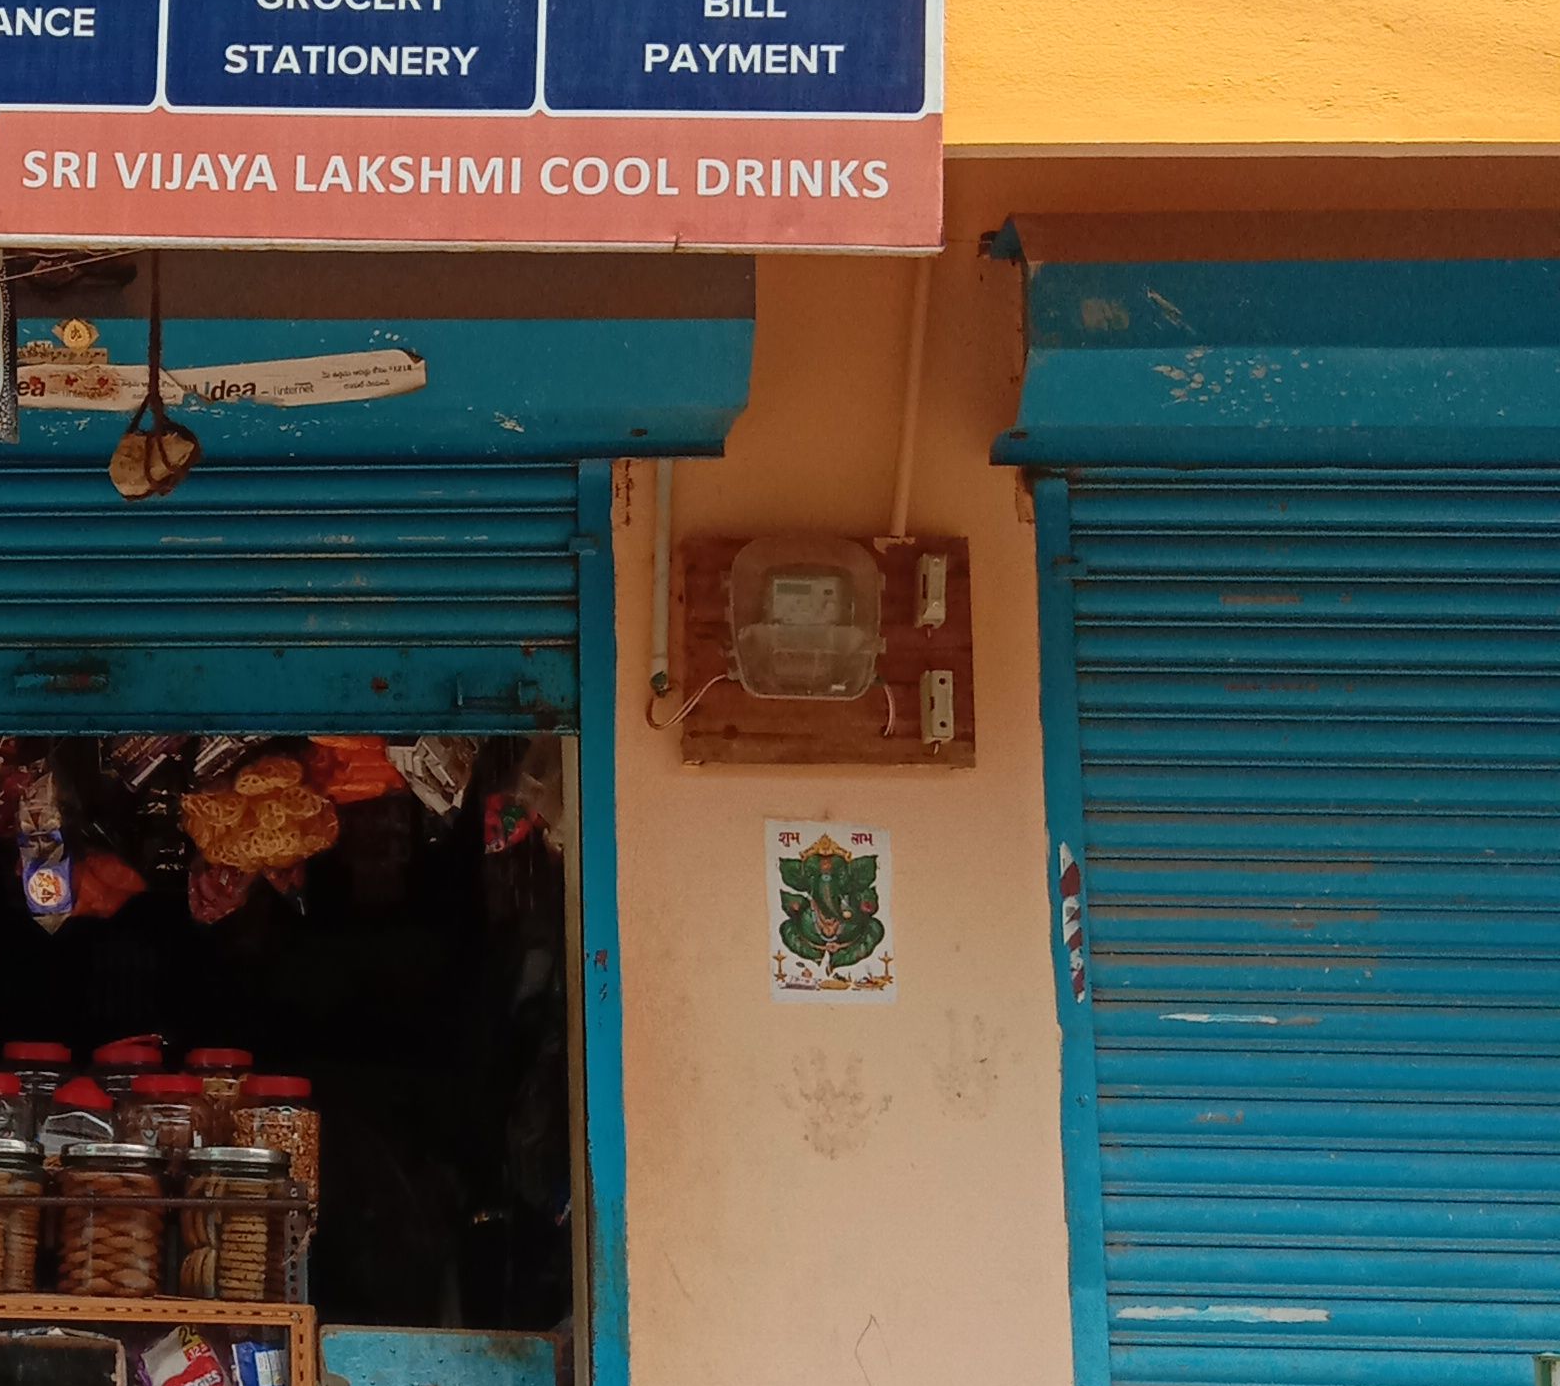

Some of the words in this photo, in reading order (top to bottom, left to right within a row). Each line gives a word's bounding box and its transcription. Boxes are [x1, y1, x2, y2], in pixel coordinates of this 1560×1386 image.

[224, 44, 479, 76] STATIONERY
[644, 43, 845, 74] PAYMENT
[22, 150, 97, 188] SRI
[114, 152, 278, 191] VIJAYA
[295, 155, 521, 194] LAKSHMI
[540, 157, 679, 195] COOL
[697, 158, 889, 199] DRINKS
[778, 831, 801, 847] शुभ
